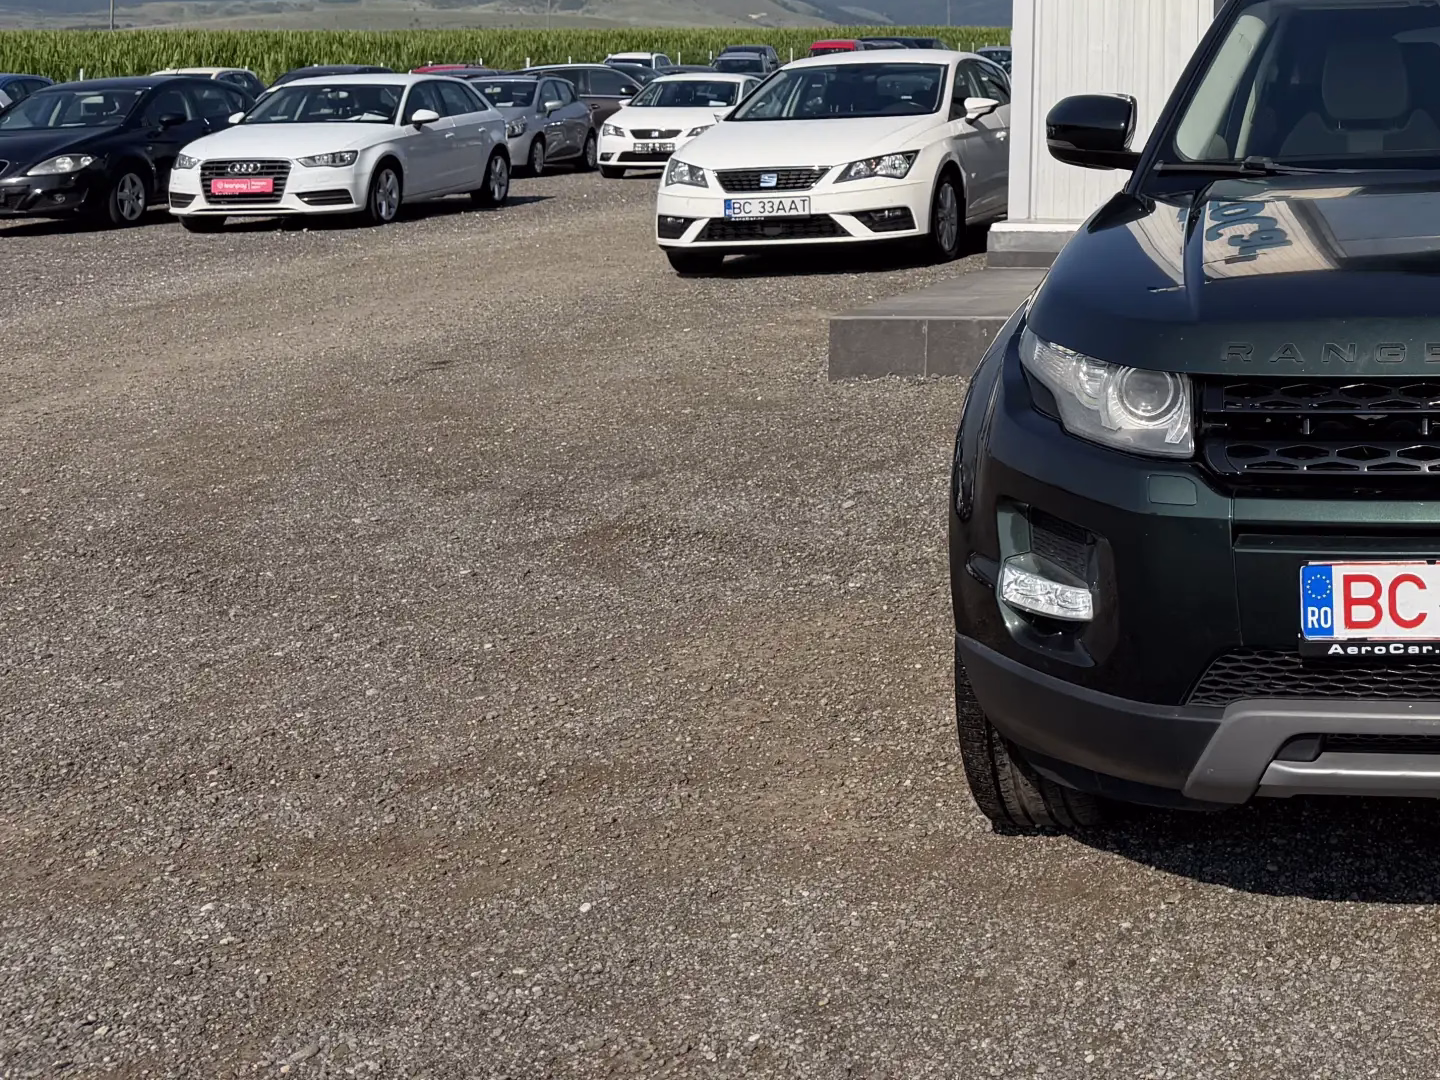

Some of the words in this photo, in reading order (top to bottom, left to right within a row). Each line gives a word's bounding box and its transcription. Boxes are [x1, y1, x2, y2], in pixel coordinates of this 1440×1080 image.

[732, 201, 752, 215] BC
[758, 199, 808, 214] 33AAT
[1342, 574, 1428, 630] BC
[1307, 607, 1332, 629] RO
